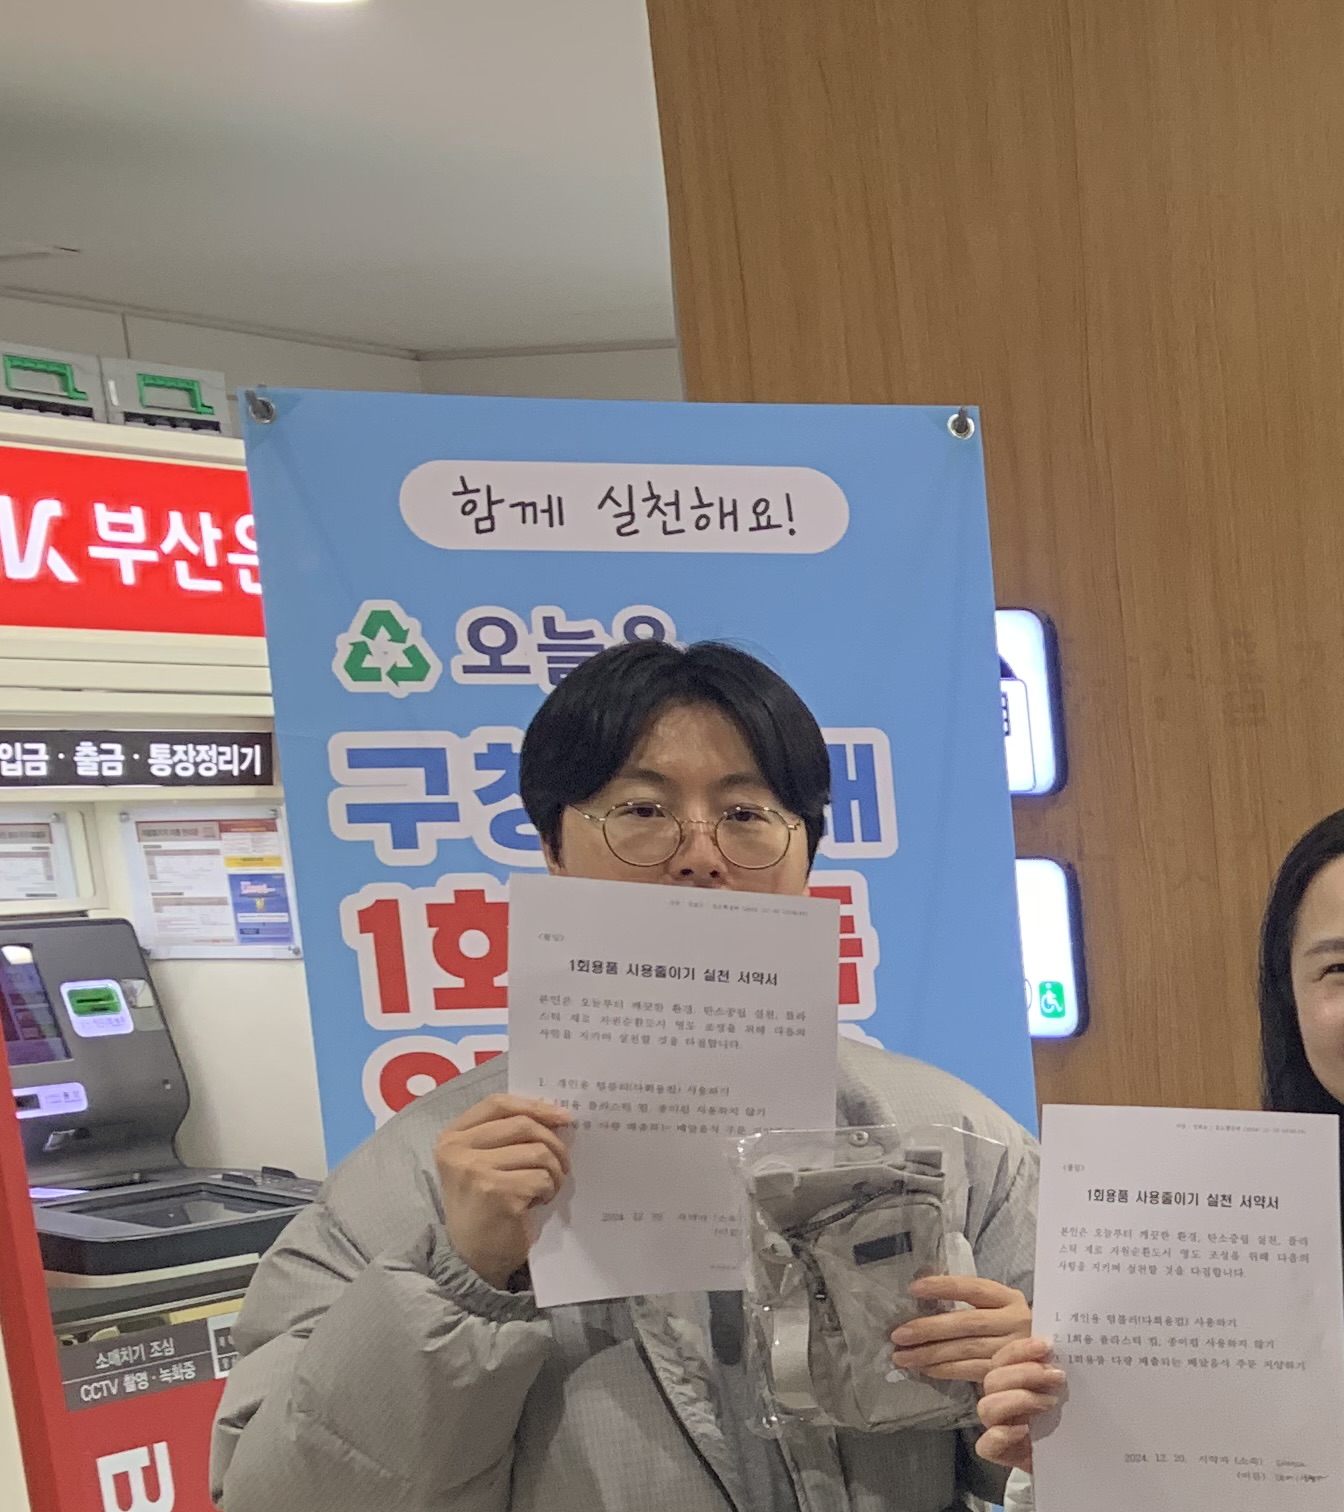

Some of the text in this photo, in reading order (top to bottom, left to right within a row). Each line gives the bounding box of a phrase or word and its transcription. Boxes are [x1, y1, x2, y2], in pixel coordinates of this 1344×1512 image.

[452, 476, 797, 536] 함께 실천해요!
[0, 741, 262, 777] 입금 출금 통장정리기
[1088, 1189, 1278, 1209] 1회용품 사용줄이기 실천 서약서
[95, 1337, 175, 1370] 소매치기 조심
[80, 1378, 120, 1402] CCTV
[123, 1371, 150, 1394] 촬영
[159, 1360, 197, 1384] 녹화중
